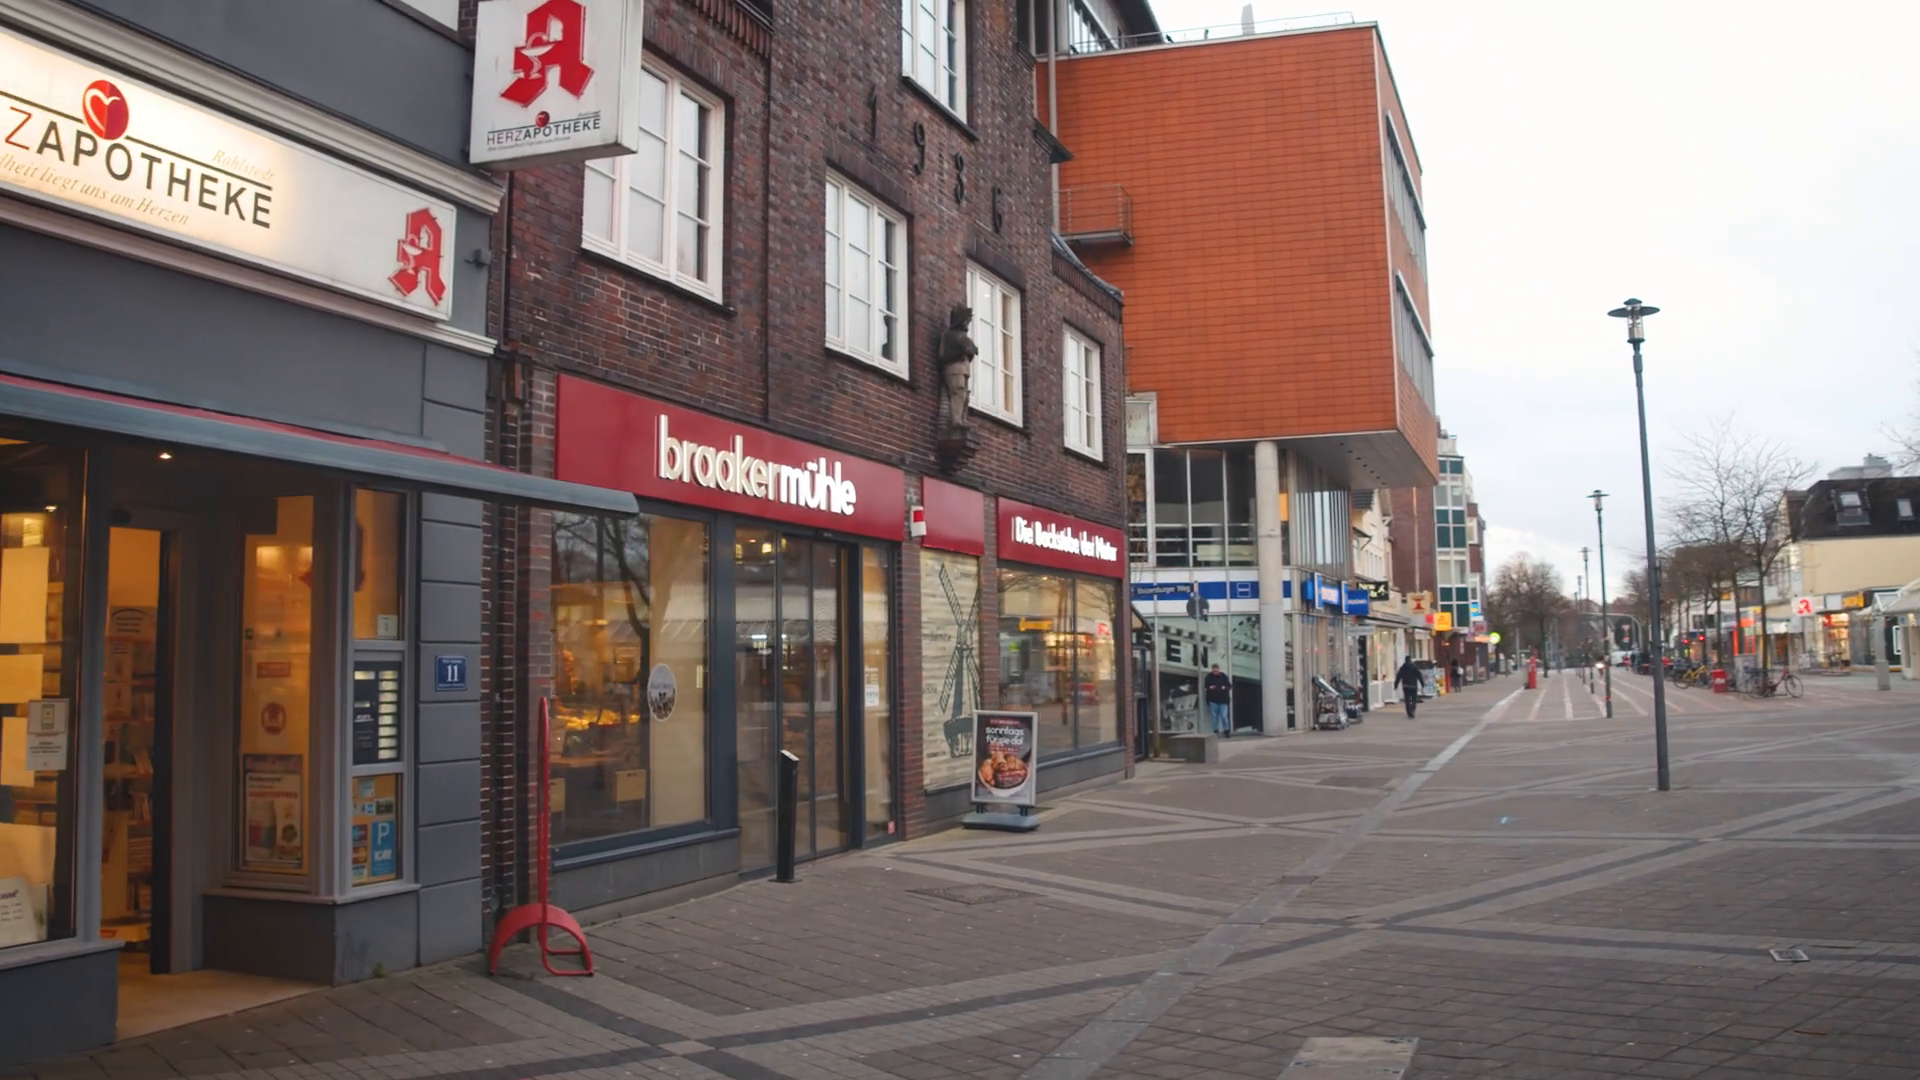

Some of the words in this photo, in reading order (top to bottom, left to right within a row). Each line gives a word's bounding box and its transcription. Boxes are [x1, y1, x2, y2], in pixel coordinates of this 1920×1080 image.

[486, 117, 602, 146] HERZAPOTHEKE
[39, 166, 79, 192] liegt
[80, 182, 109, 200] uns
[111, 193, 135, 210] am
[136, 197, 190, 226] Herzen
[656, 414, 858, 516] braakermühle
[446, 664, 460, 682] 11
